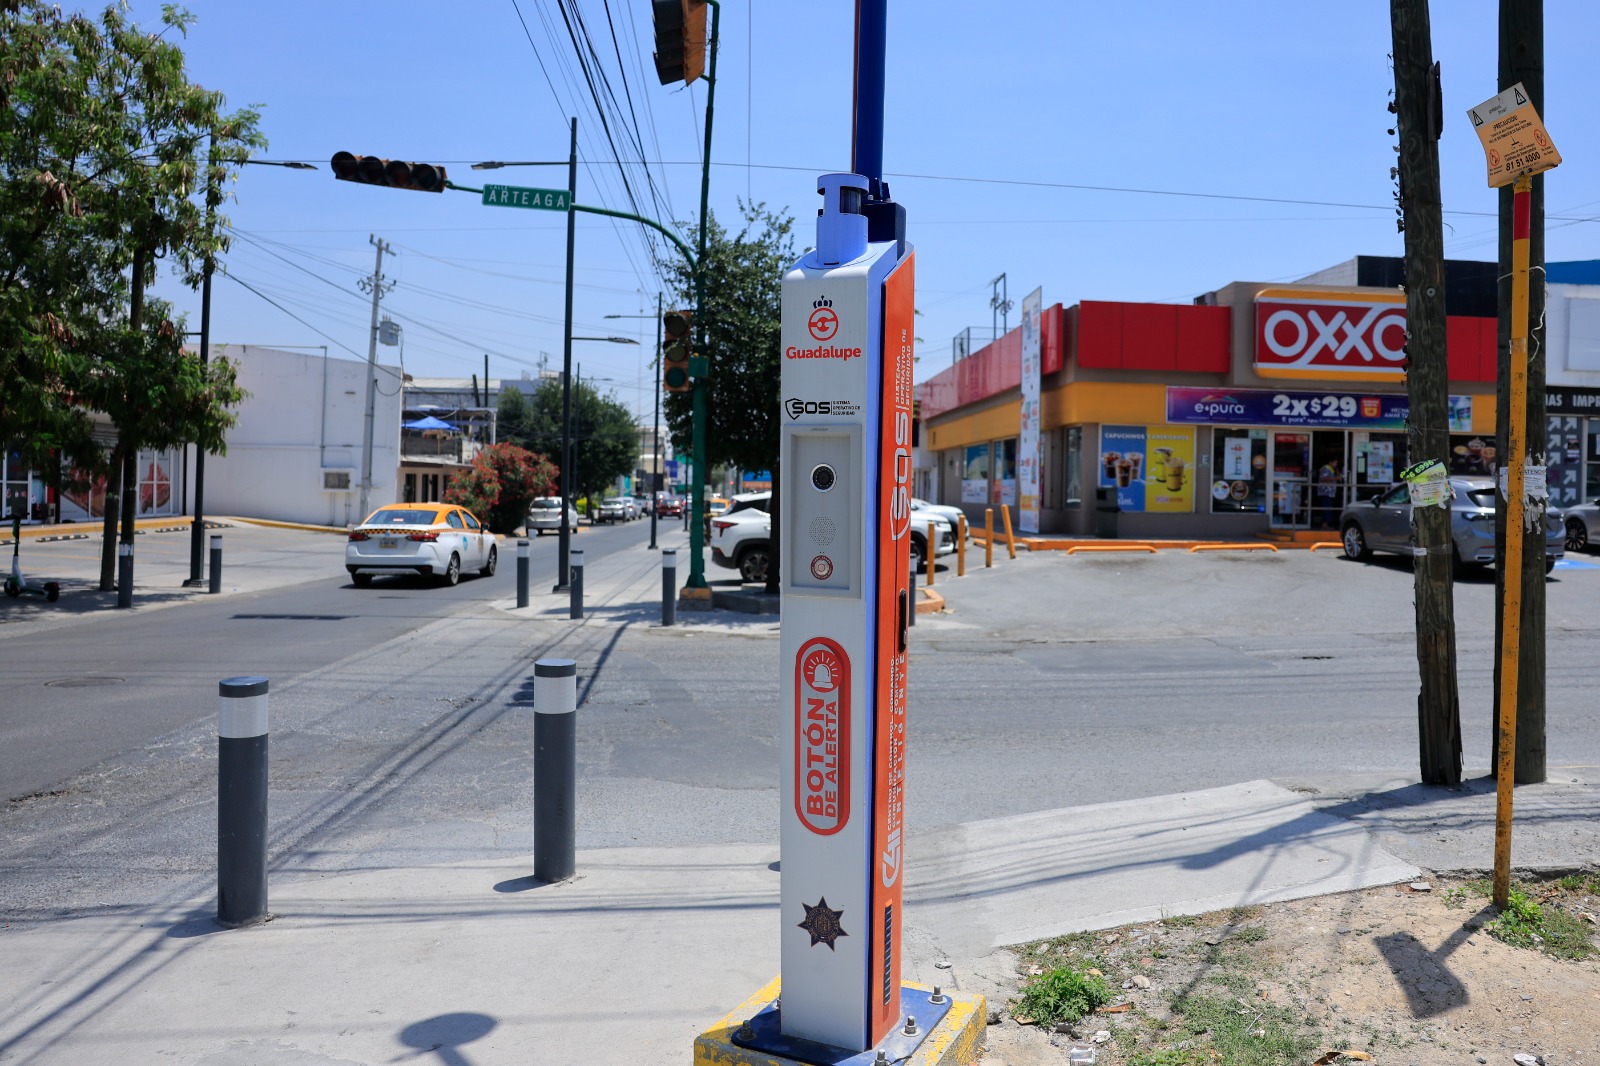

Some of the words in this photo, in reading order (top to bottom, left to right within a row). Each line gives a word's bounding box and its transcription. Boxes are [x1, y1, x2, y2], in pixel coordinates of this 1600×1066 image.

[488, 189, 565, 208] ARTEAGA
[902, 329, 907, 342] DE
[1264, 309, 1407, 362] OXXO
[786, 346, 861, 361] Guadalupe
[792, 401, 831, 415] SOS
[1273, 394, 1358, 418] 2x$29
[893, 412, 909, 521] SOS
[825, 700, 837, 785] ALERTA
[802, 697, 825, 816] BOTÓN
[888, 772, 893, 786] DE
[825, 790, 837, 818] DE
